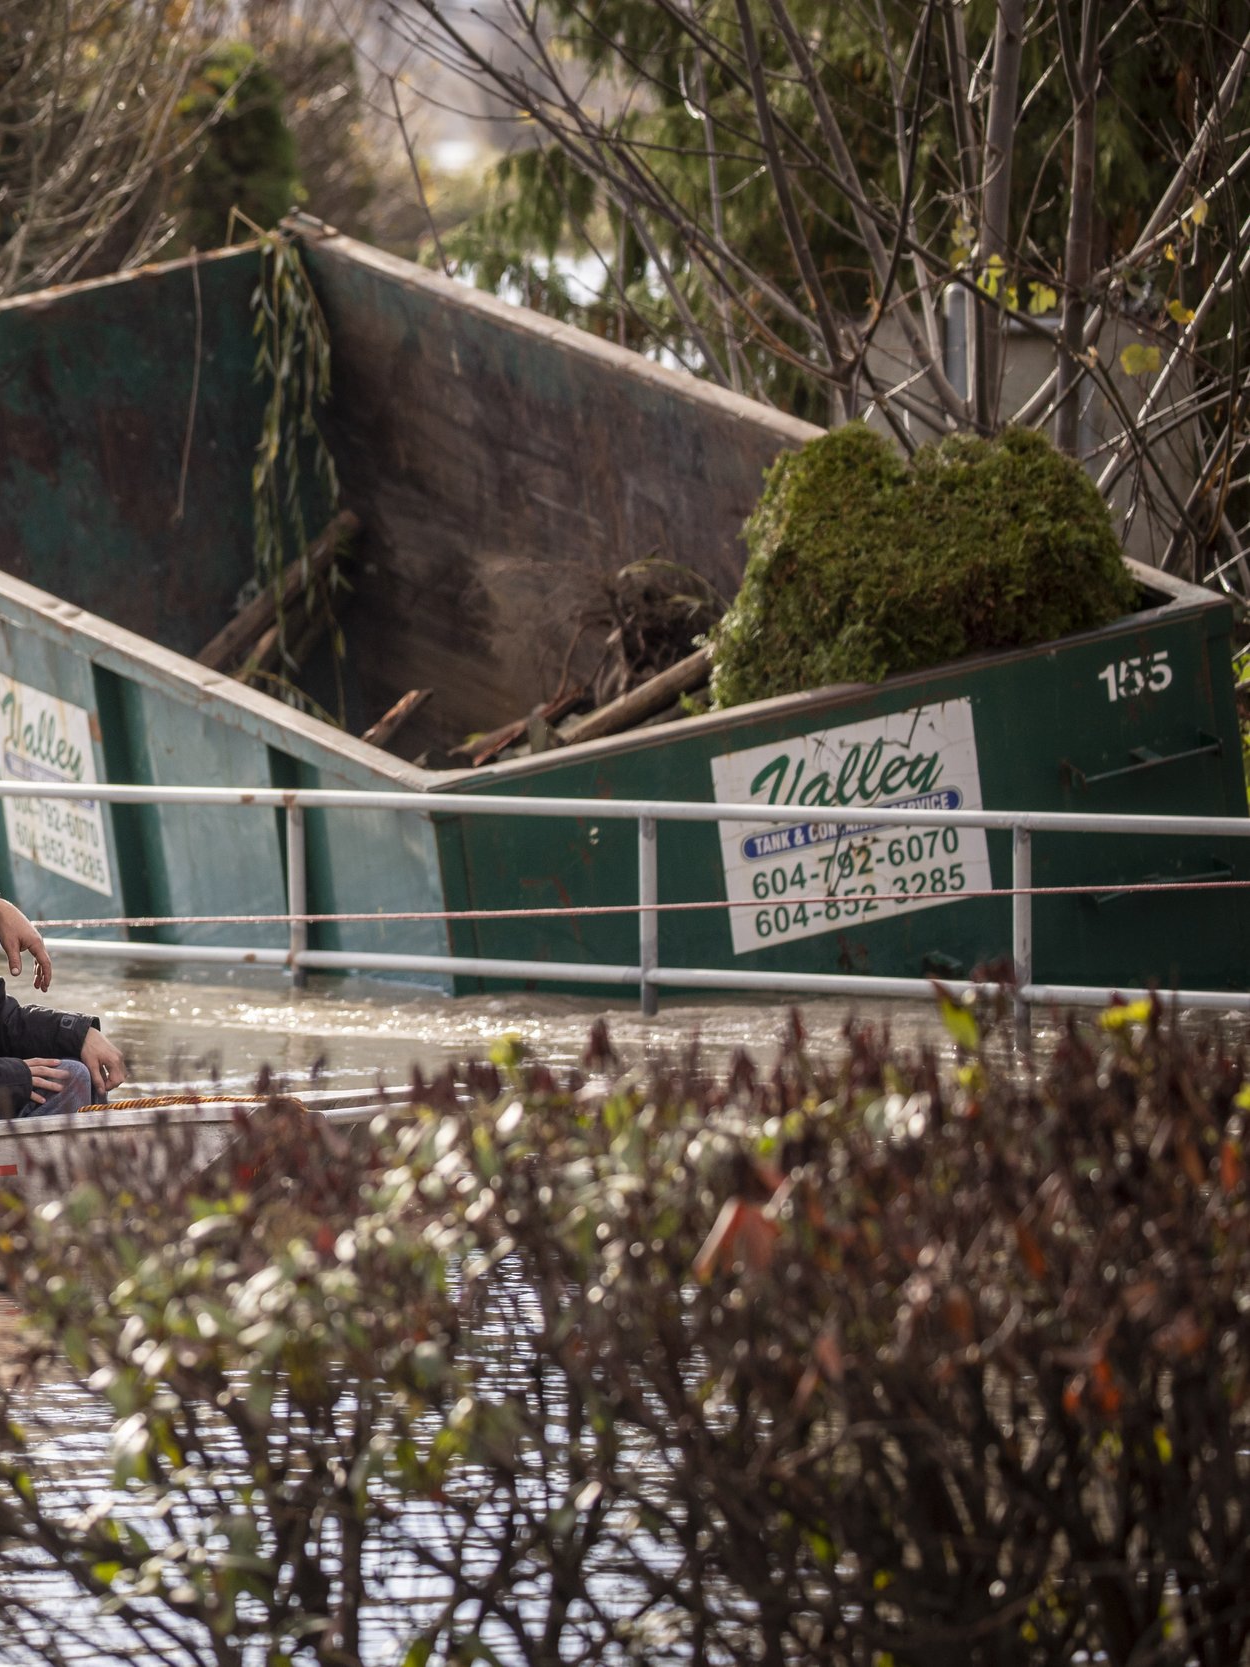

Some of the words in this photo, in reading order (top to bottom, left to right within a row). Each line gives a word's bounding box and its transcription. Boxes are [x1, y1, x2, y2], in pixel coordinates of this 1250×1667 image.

[1098, 649, 1172, 702] 155
[1, 692, 83, 781] Valley
[750, 736, 943, 806] Valley
[752, 826, 959, 900] 604-792-6070
[753, 830, 791, 855] TANK
[793, 828, 805, 845] &
[755, 863, 966, 948] 604-8523285
